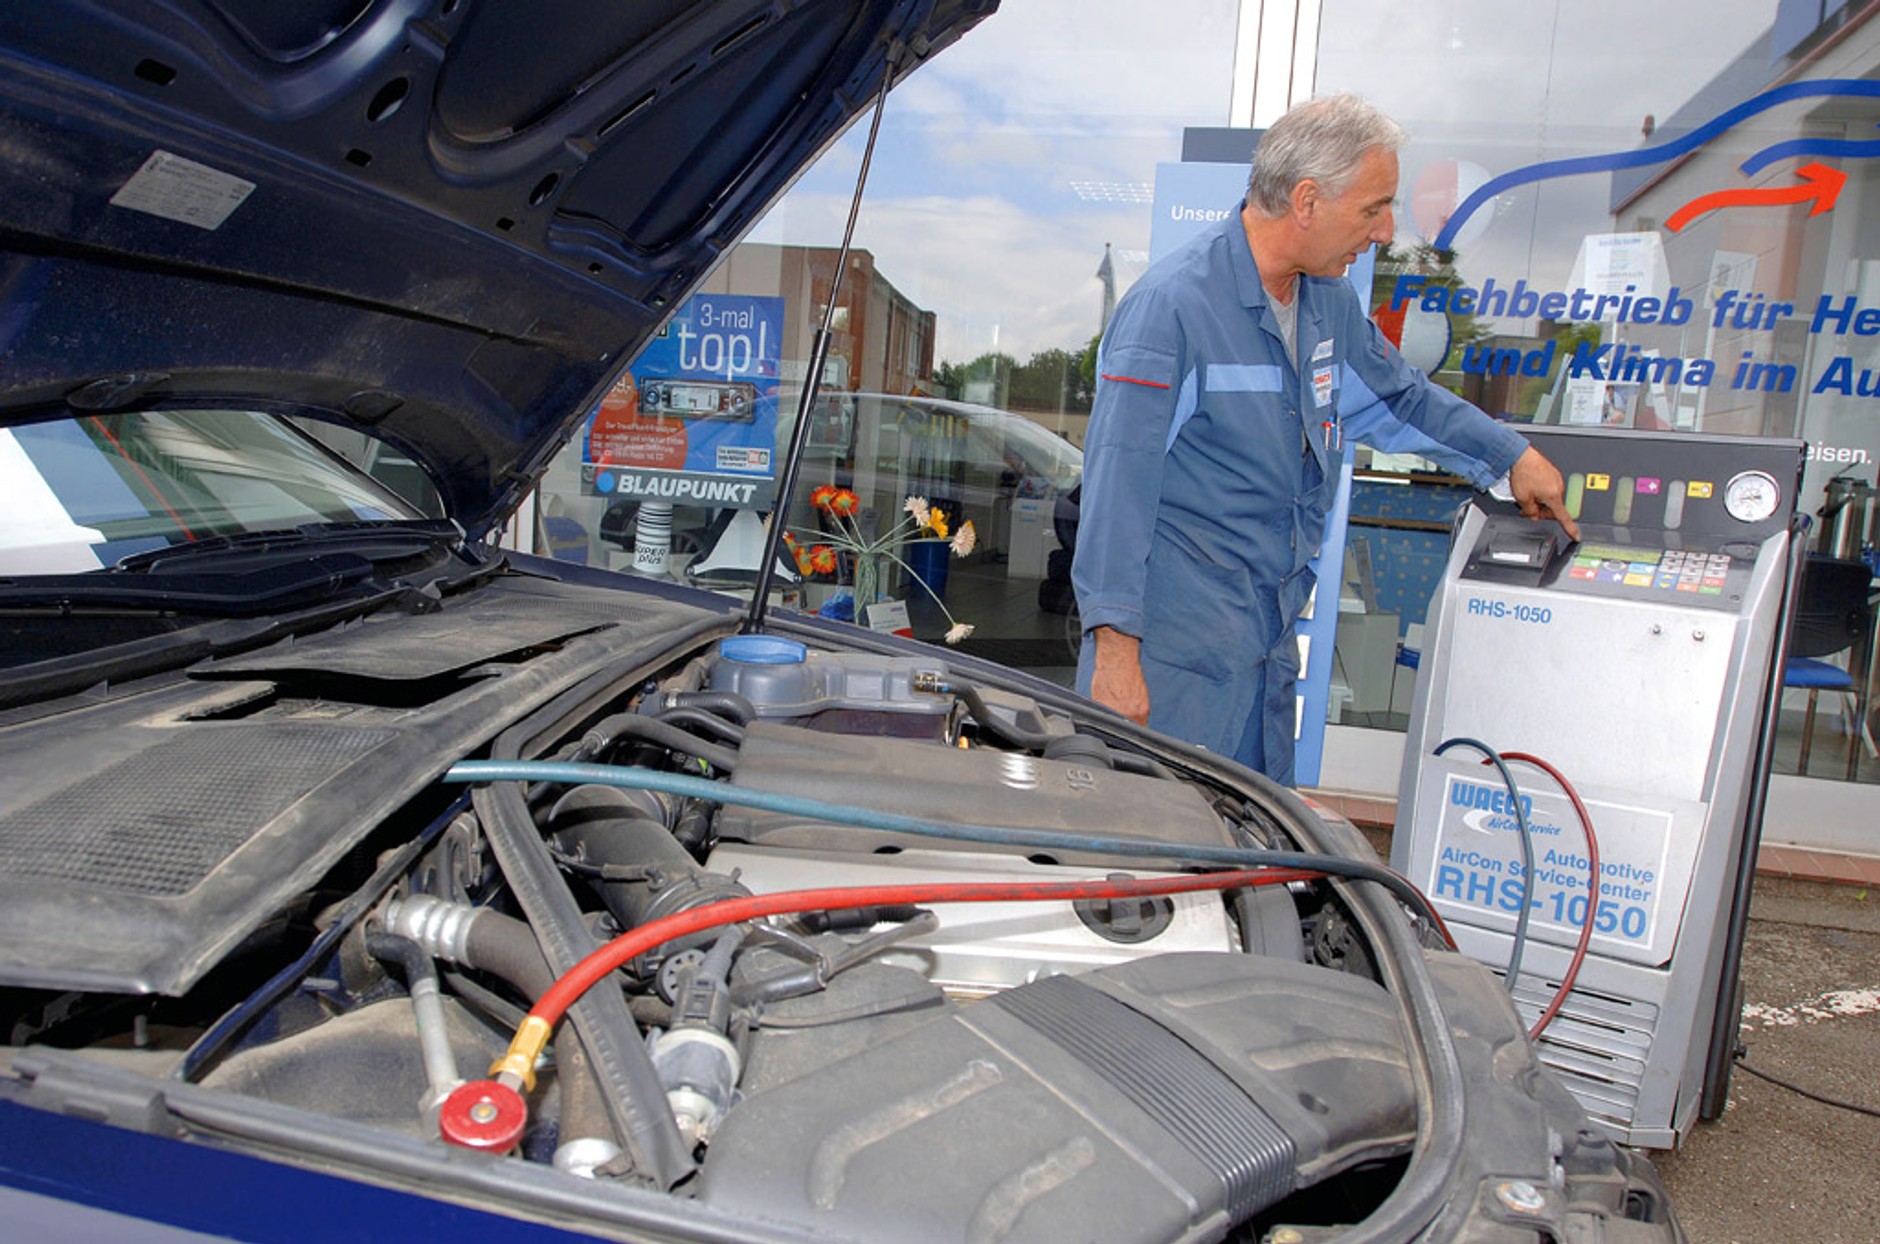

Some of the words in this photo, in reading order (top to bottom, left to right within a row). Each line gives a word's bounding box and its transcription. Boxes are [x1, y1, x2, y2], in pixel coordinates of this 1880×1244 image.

[701, 303, 754, 329] 3-mal
[1390, 275, 1693, 326] Fachbetrieb
[1713, 289, 1794, 331] für
[1810, 294, 1880, 336] He
[678, 321, 767, 382] top!
[1461, 339, 1557, 377] und
[1569, 341, 1716, 387] Klima
[1731, 351, 1797, 393] im
[1812, 356, 1880, 398] Au
[617, 474, 757, 504] BLAUPUNKT
[1468, 597, 1552, 623] RHS-1050
[1451, 782, 1532, 818] WAECO
[1441, 846, 1503, 873] AirCon
[1436, 864, 1647, 939] RHS-1050
